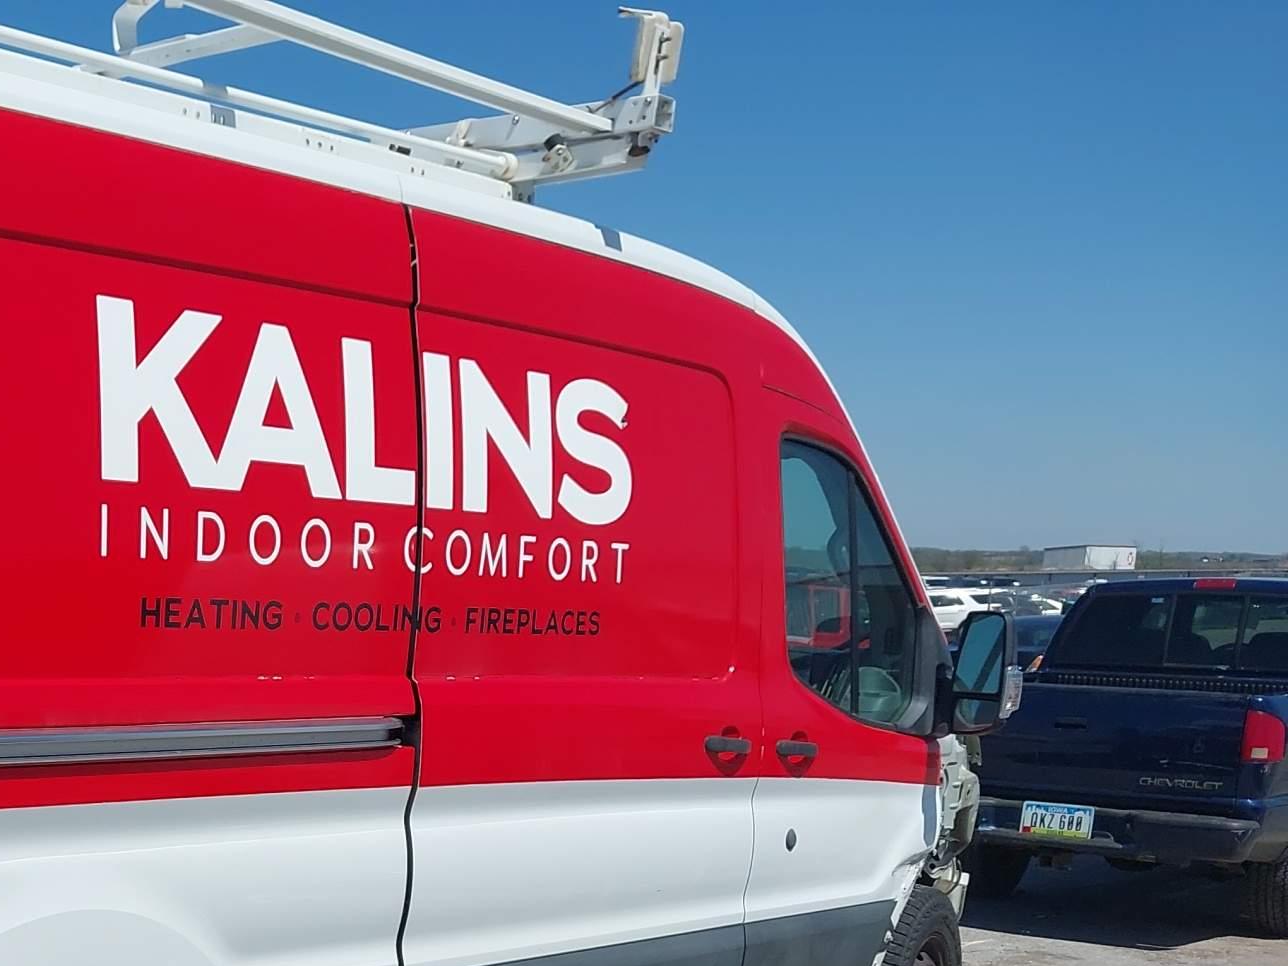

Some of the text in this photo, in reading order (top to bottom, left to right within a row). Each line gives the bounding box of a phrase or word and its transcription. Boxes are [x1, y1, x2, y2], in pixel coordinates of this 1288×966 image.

[96, 294, 632, 525] KALINS
[100, 504, 630, 584] INDOOR COMFORT
[139, 597, 600, 636] HEATING COOLING FIREPLACES
[1138, 776, 1224, 790] CHEVROLET
[1058, 814, 1083, 832] 600
